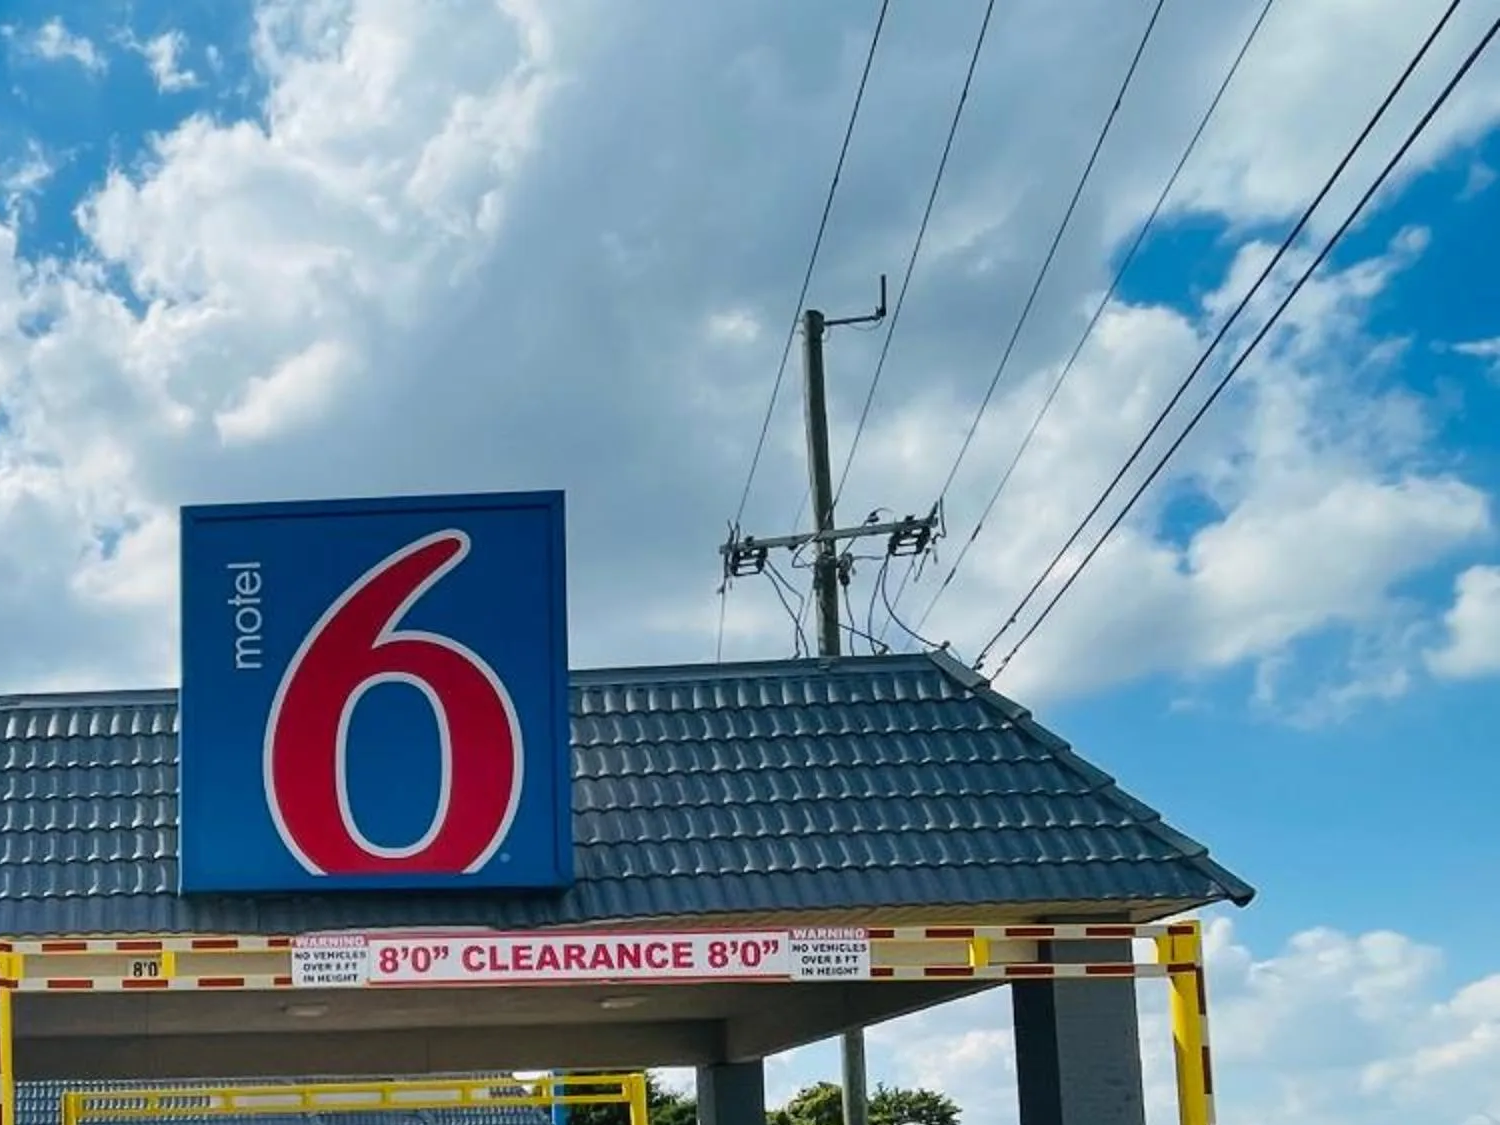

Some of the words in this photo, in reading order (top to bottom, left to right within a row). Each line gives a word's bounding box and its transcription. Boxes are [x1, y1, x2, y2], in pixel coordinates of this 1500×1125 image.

[227, 561, 262, 670] motel
[263, 528, 524, 876] 6
[793, 928, 865, 939] WARNING
[295, 936, 365, 947] WARNING
[792, 943, 808, 952] NO
[812, 943, 867, 952] VEHICLES
[294, 951, 310, 960] NO
[313, 951, 367, 960] VEHICLES
[462, 939, 694, 972] CLEARANCE
[801, 955, 831, 964] OVER
[845, 955, 858, 964] FT
[303, 962, 331, 971] OVER
[345, 961, 357, 970] FT
[801, 967, 813, 976] IN
[817, 967, 858, 976] HEIGHT
[303, 974, 314, 982] IN
[318, 973, 358, 982] HEIGHT
